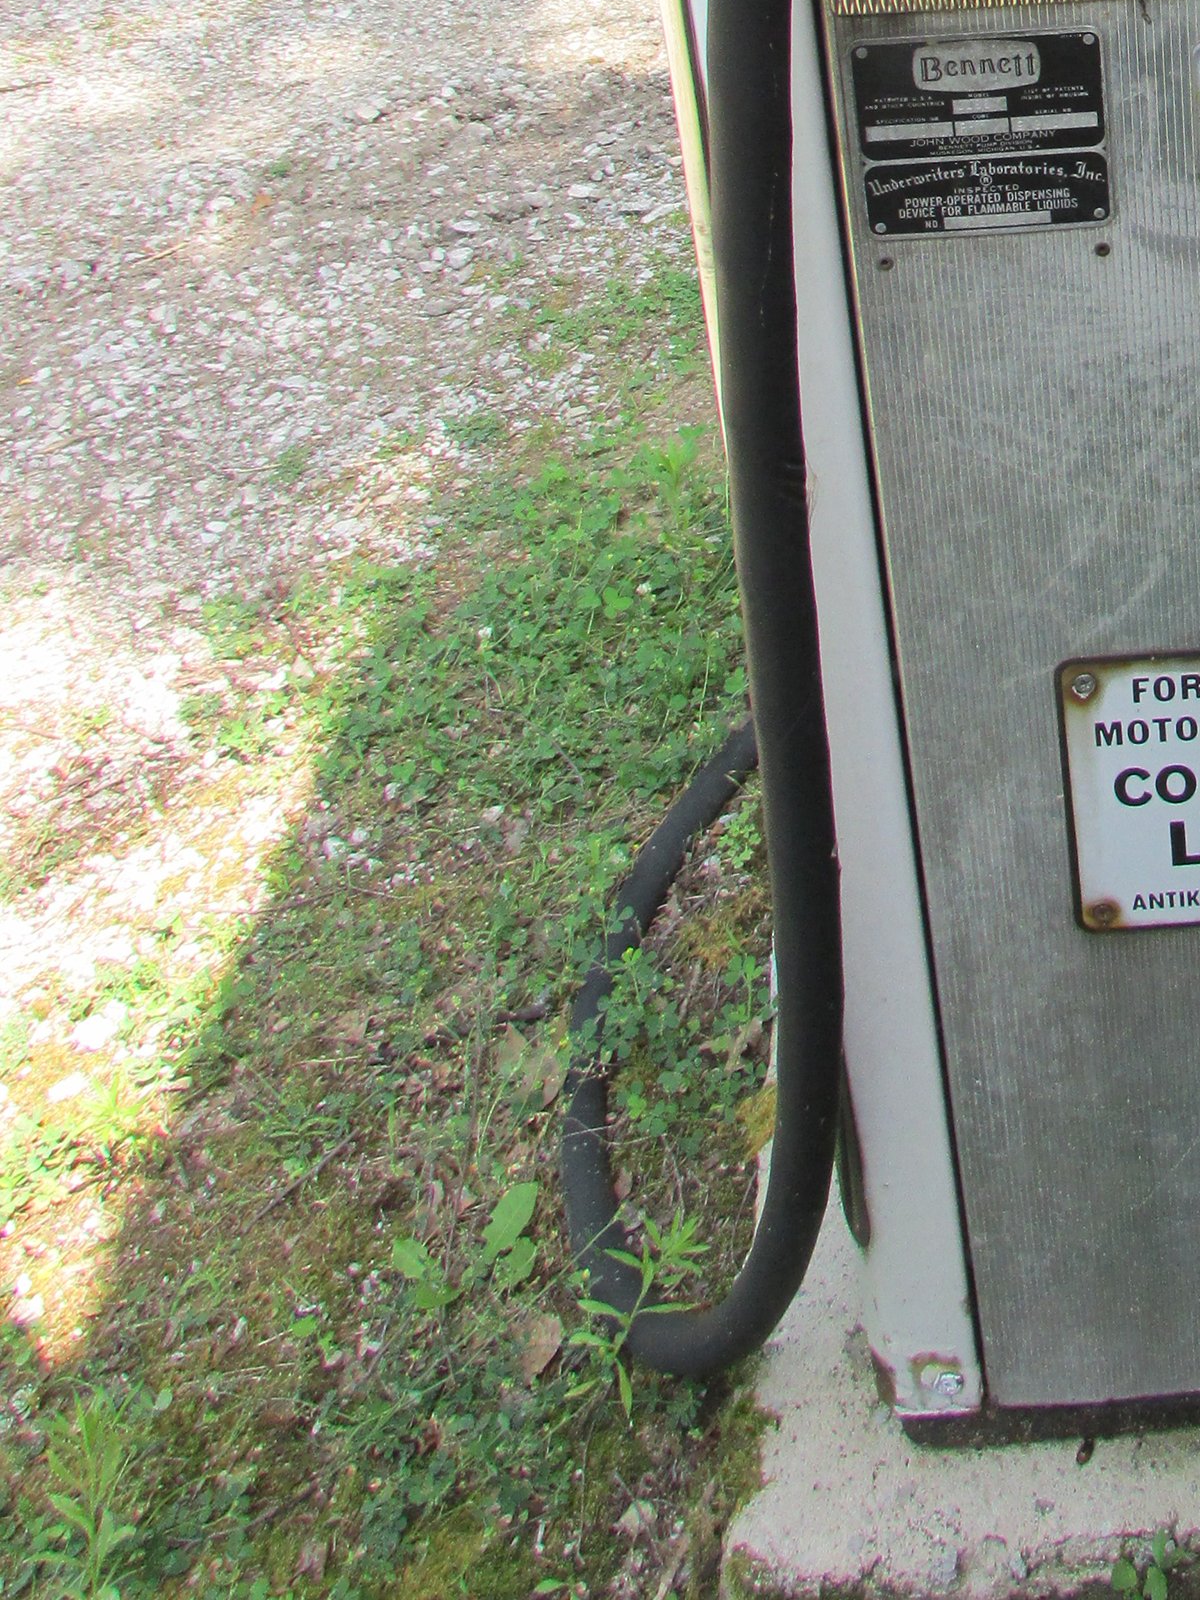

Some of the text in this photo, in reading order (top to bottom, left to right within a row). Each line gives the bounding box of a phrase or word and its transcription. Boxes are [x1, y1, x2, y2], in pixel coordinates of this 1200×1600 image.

[920, 52, 1037, 82] Bennett
[910, 129, 1057, 148] JOHN WOOD COMPANY
[938, 143, 973, 151] BENNETT
[1000, 139, 1034, 147] DIVISION
[1070, 161, 1105, 182] Inc.
[904, 187, 1071, 208] POWER-OPERATED DISPENSING
[954, 183, 1020, 194] INSPECTED
[899, 198, 1079, 219] DEVICE FOR FLAMMABLE LIQUIDS
